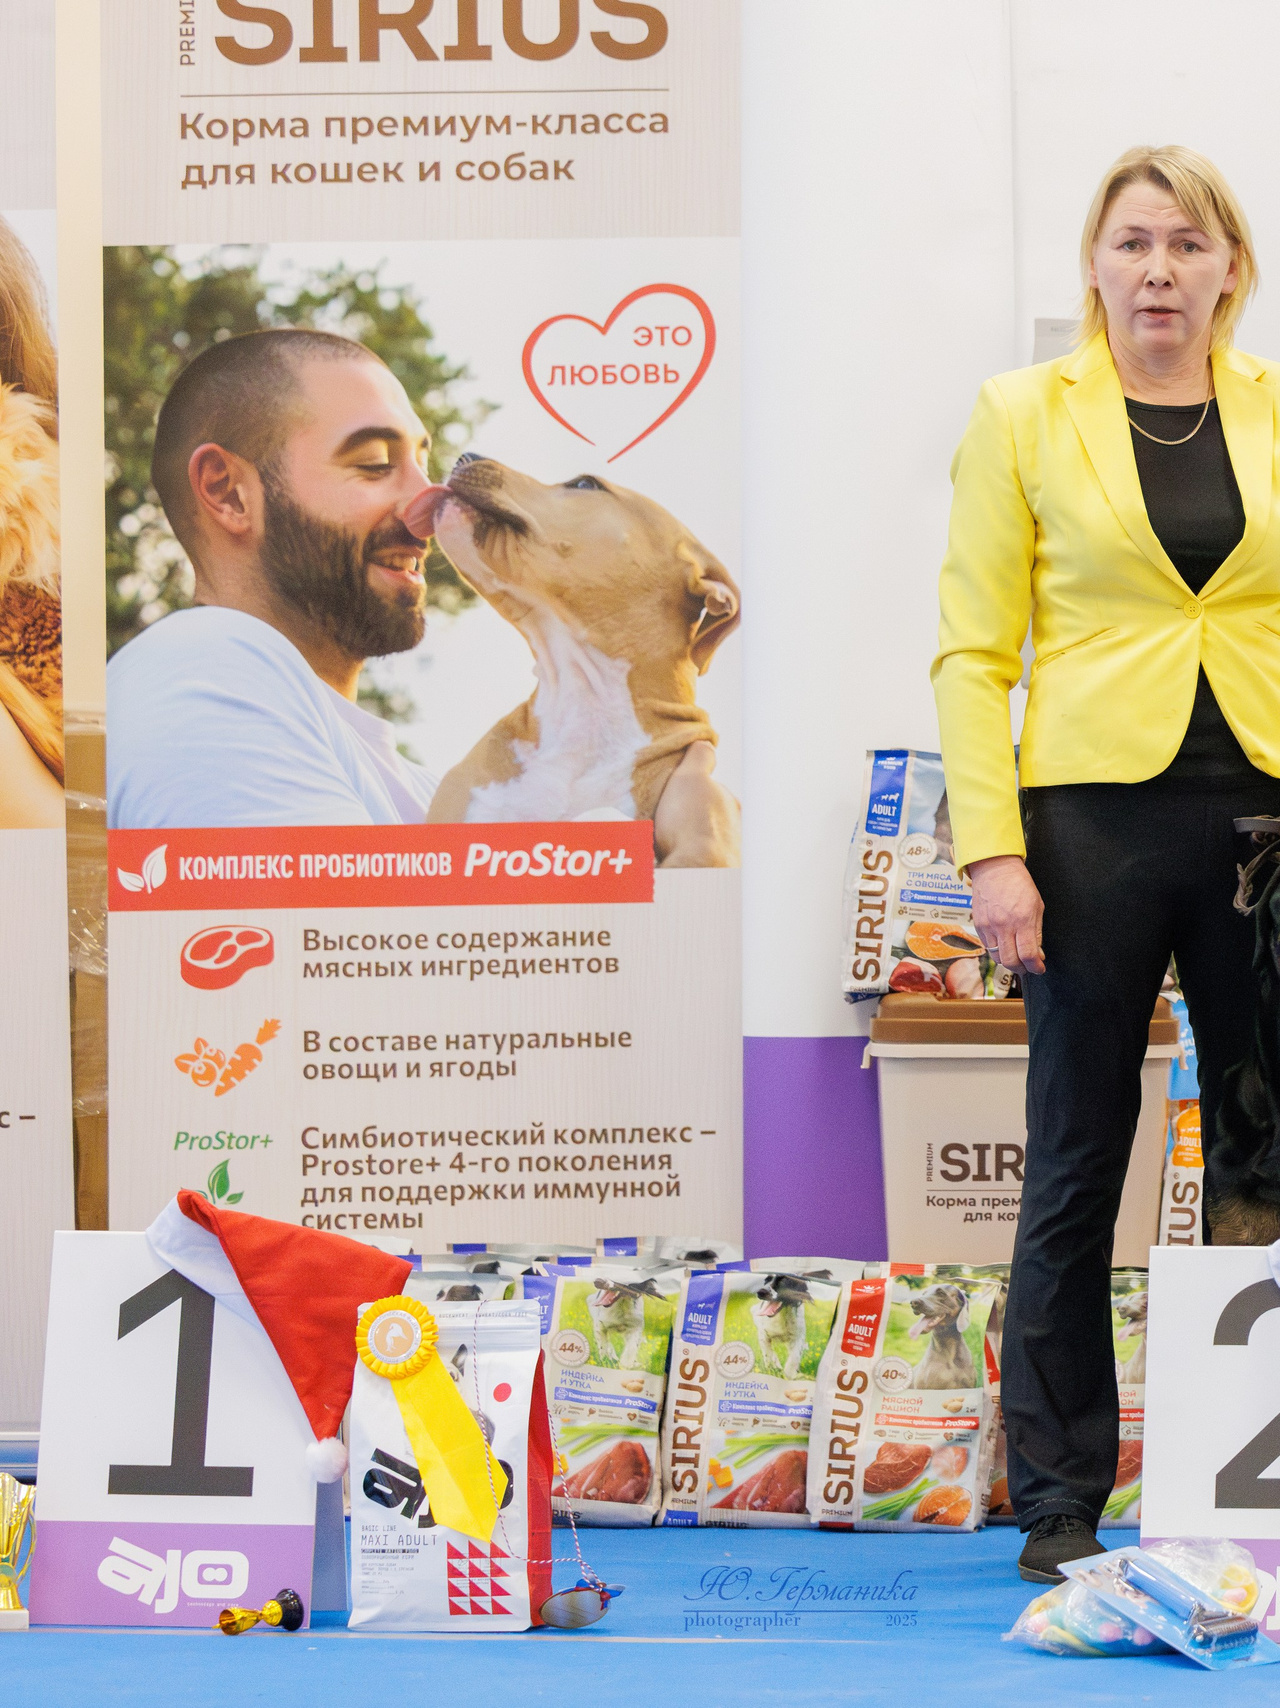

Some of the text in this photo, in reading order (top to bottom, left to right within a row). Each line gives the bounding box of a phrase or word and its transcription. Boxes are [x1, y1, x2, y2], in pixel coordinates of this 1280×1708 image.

[179, 106, 671, 145] Корма премиум-класса
[180, 152, 575, 190] для кошек и собак
[633, 325, 694, 349] ЭТО
[546, 363, 680, 388] ЛЮБОВЬ
[871, 803, 897, 817] ADULT
[906, 845, 931, 856] 48%
[178, 842, 633, 882] КОМПЛЕКС ПРОБИОТИКОВ ProStor+
[907, 871, 952, 882] ТРИ МЯСА
[906, 879, 964, 892] С ОВОЩАМИ
[852, 849, 893, 982] SIRIUS
[302, 928, 612, 953] Высокое содержание
[302, 955, 620, 981] мясных ингредиентов
[302, 1028, 633, 1054] В составе натуральные
[302, 1058, 518, 1084] овощи и ягоды
[173, 1129, 274, 1153] ProStor+
[301, 1123, 693, 1151] Симбиотический комплекс
[301, 1149, 673, 1178] Prostore+ 4-го поколения
[926, 1142, 934, 1182] PREMIUM
[301, 1173, 682, 1207] для поддержки иммунной
[926, 1195, 977, 1209] Корма
[301, 1208, 424, 1232] системы
[963, 1212, 993, 1223] для
[687, 1311, 713, 1325] ADULT
[847, 1323, 874, 1337] ADULT
[558, 1341, 584, 1354] 44%
[723, 1354, 748, 1365] 44%
[560, 1368, 605, 1384] ИНДЕЙКА
[881, 1368, 907, 1380] 40%
[107, 1268, 255, 1497] 1
[569, 1379, 592, 1390] УТКА
[725, 1381, 769, 1391] ИНДЕЙКА
[732, 1390, 756, 1398] УТКА
[882, 1395, 923, 1406] МЯСНОЙ
[788, 1406, 813, 1416] ProSto
[881, 1404, 920, 1414] РАЦИОН
[670, 1357, 710, 1495] SIRIUS
[823, 1368, 869, 1506] SIRIUS
[821, 1508, 853, 1516] PREMIUM
[360, 1534, 438, 1546] MAXI ADULT
